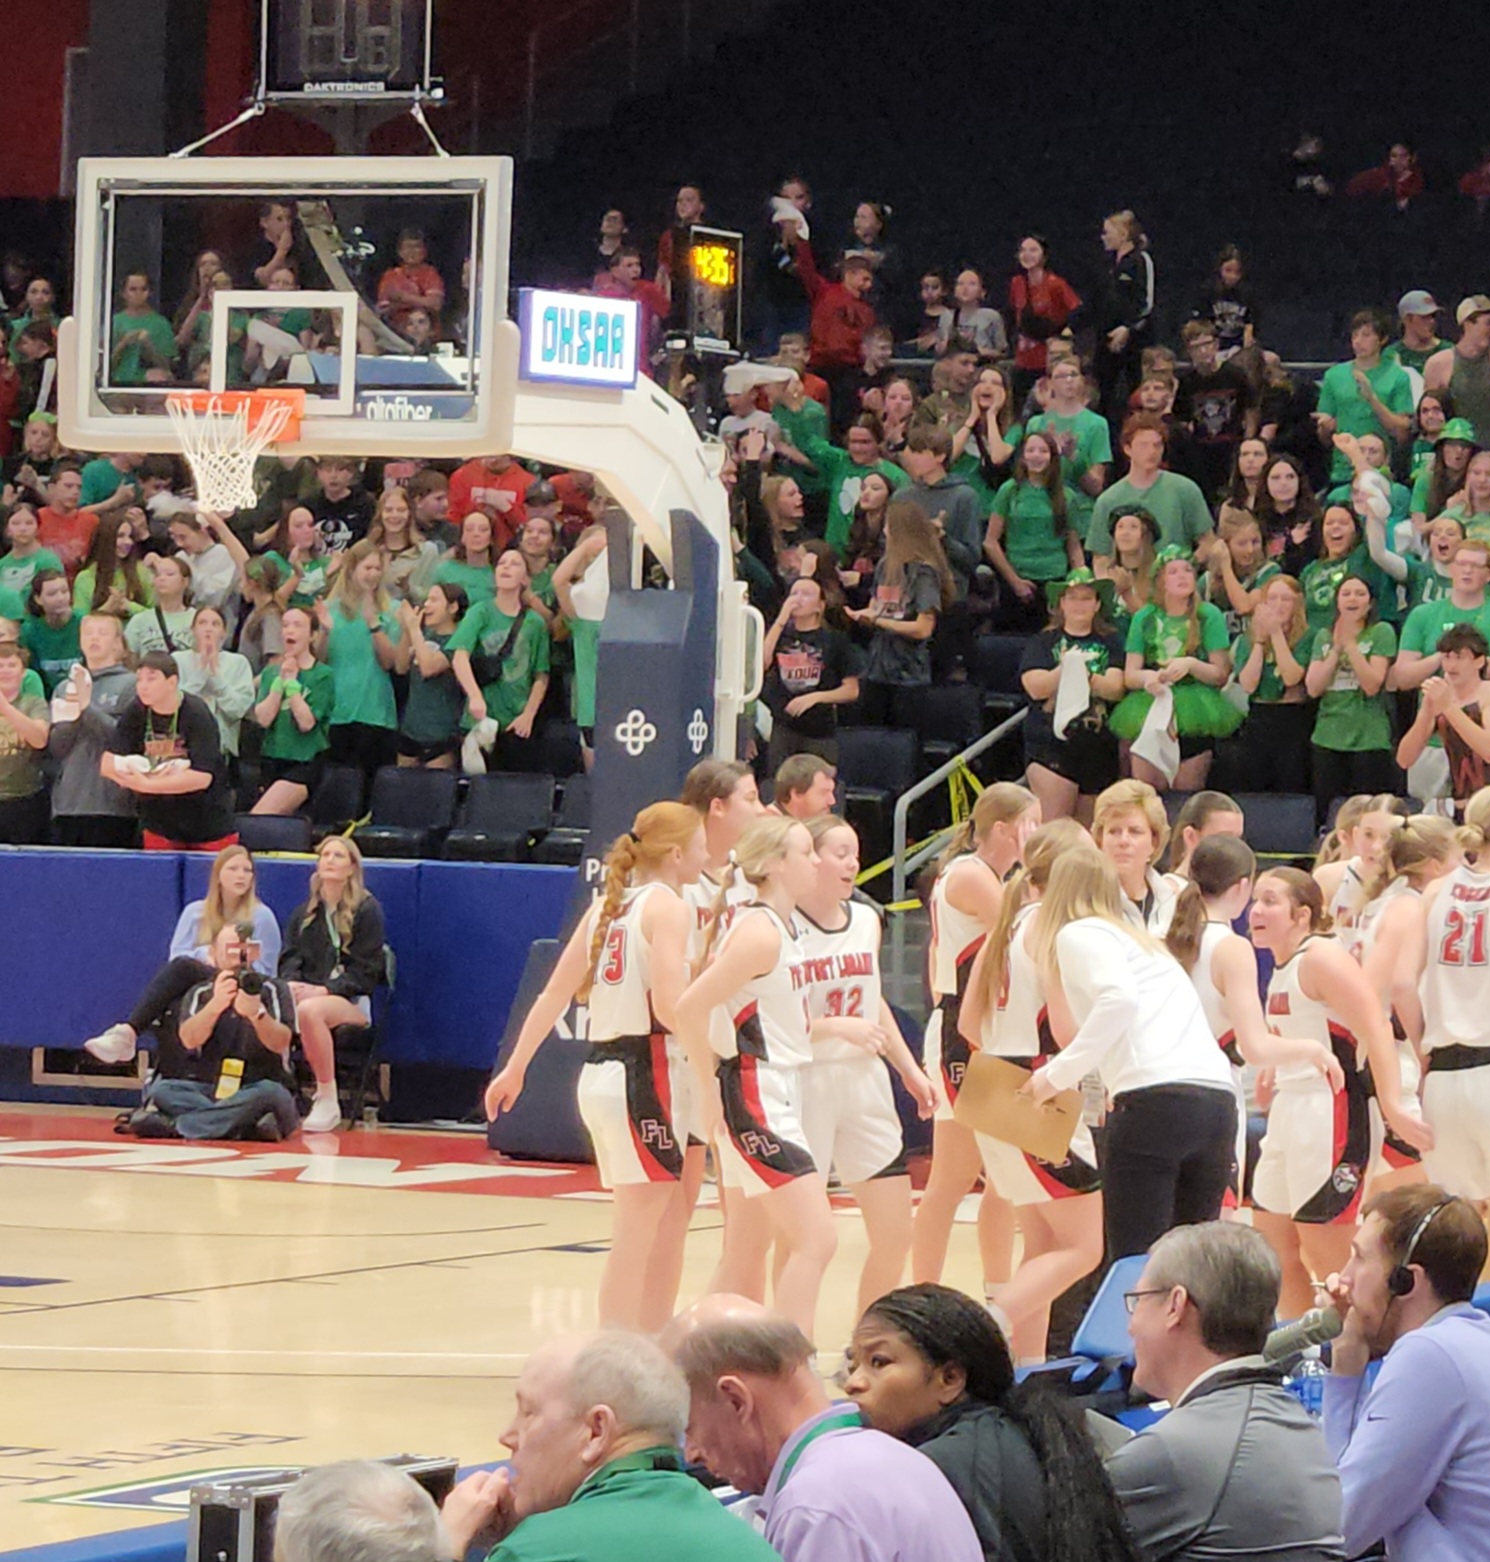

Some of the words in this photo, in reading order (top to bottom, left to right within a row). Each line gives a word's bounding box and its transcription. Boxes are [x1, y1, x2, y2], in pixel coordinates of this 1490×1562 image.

[303, 82, 385, 92] DAKTRONICS
[541, 305, 625, 370] OHSAA
[1438, 905, 1488, 967] 21
[824, 986, 864, 1018] 32
[950, 1062, 967, 1084] F
[641, 1119, 673, 1150] FL
[741, 1130, 781, 1157] FL
[34, 1431, 306, 1469] FIFTH
